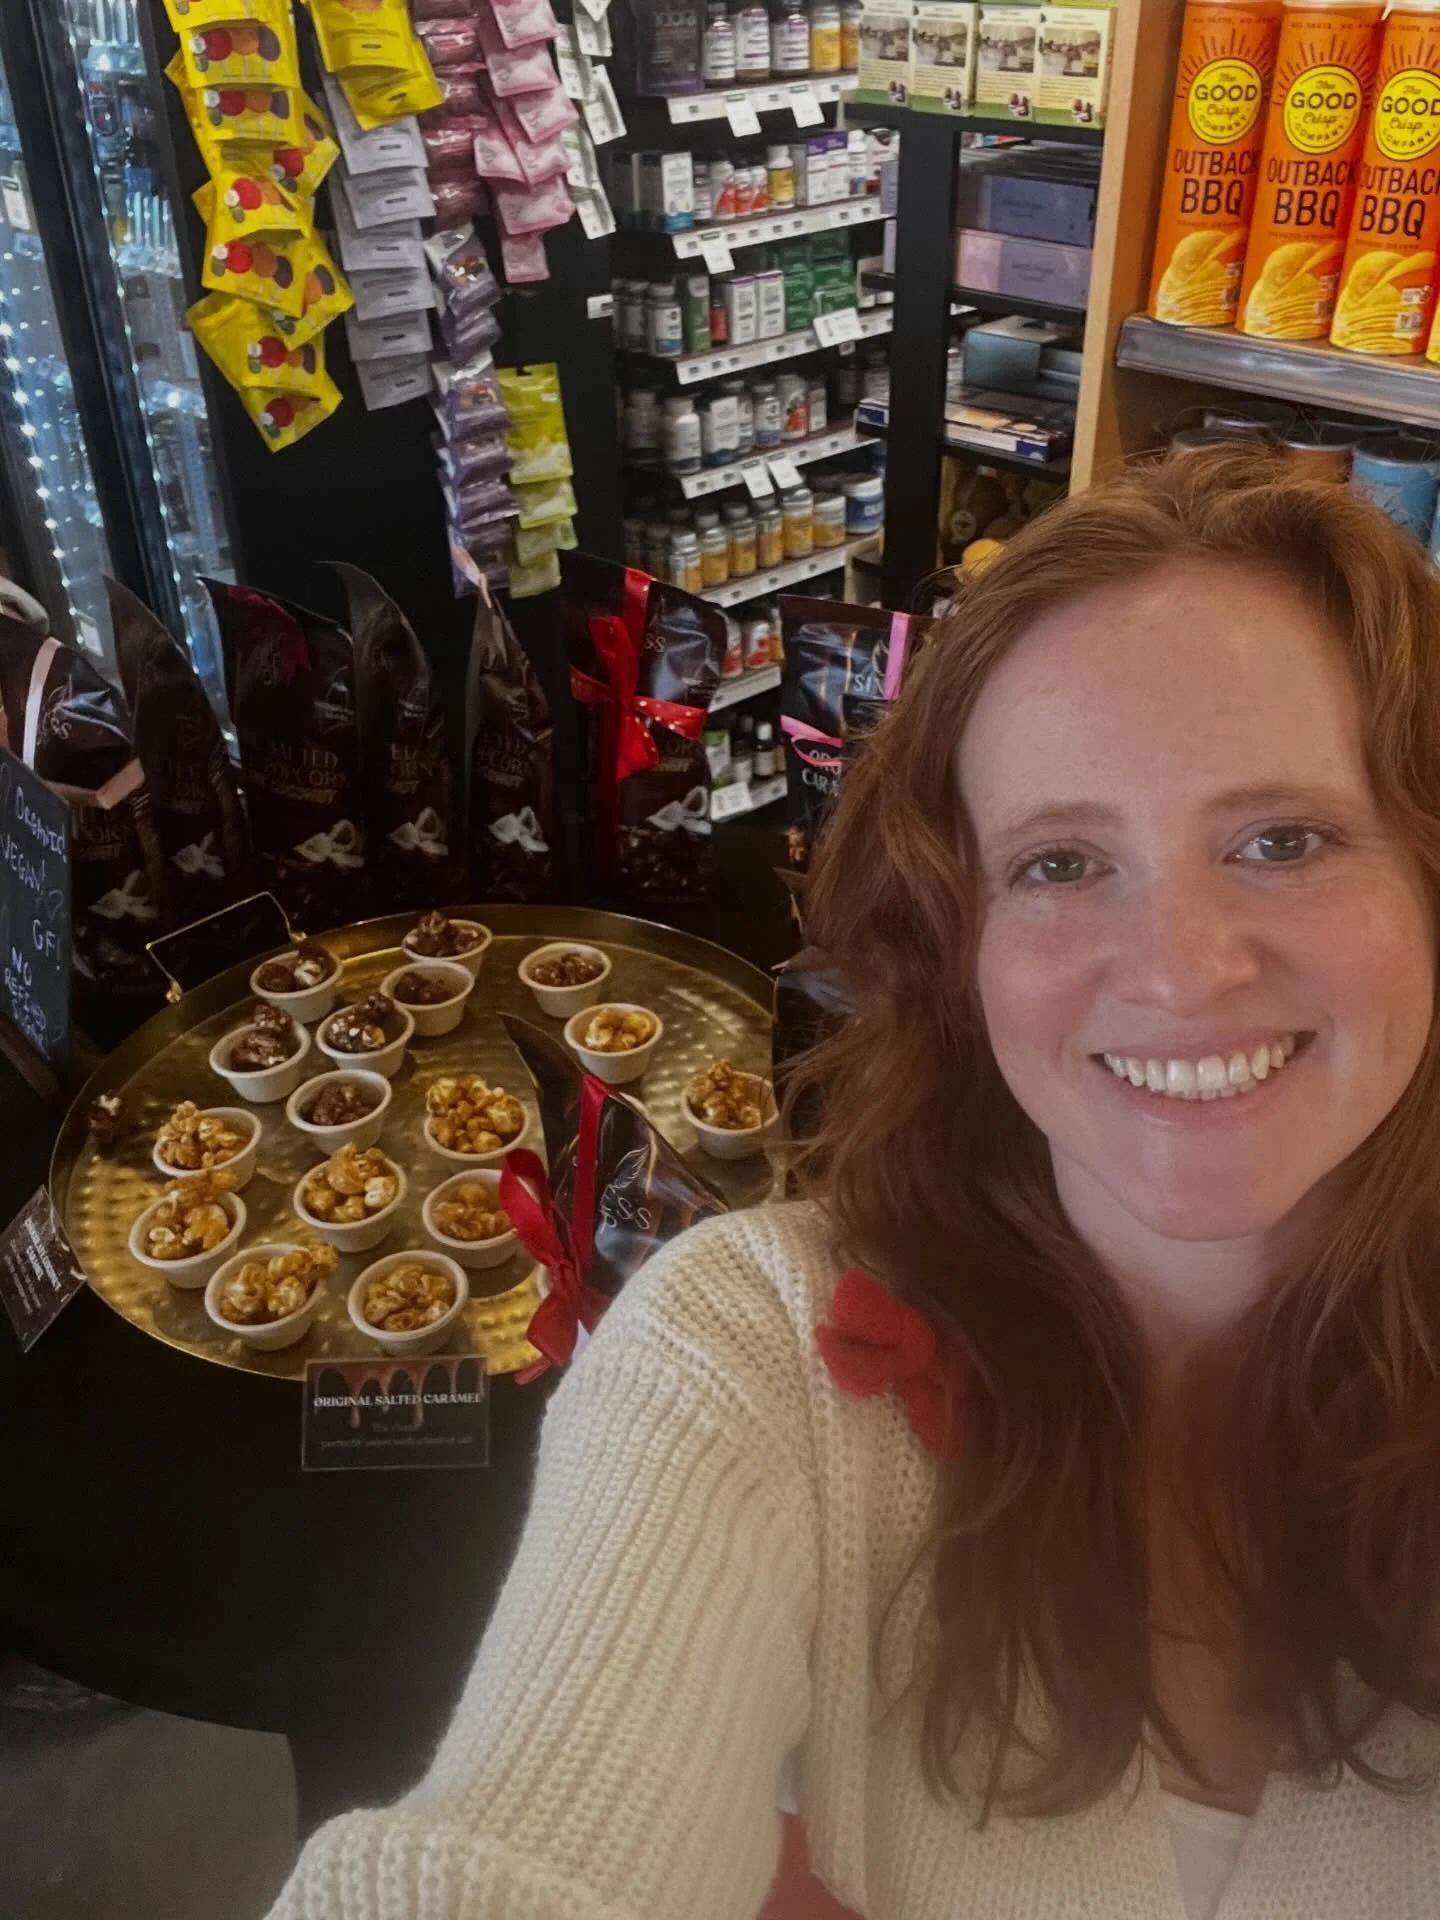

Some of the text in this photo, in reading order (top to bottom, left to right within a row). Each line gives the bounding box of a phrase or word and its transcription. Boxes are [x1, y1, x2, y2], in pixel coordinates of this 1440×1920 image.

[1194, 83, 1258, 102] GOOD
[1290, 91, 1358, 111] GOOD
[1302, 111, 1338, 130] Crisp
[1389, 116, 1425, 135] Crisp
[1294, 122, 1346, 142] COMPANY
[1382, 127, 1433, 149] COMPANY
[1180, 177, 1245, 217] BBQ
[1273, 187, 1341, 229] BBQ
[1359, 194, 1426, 241] BBQ
[12, 945, 33, 987] NO
[313, 1392, 482, 1408] ORIGINAL SALTED CARAMEL
